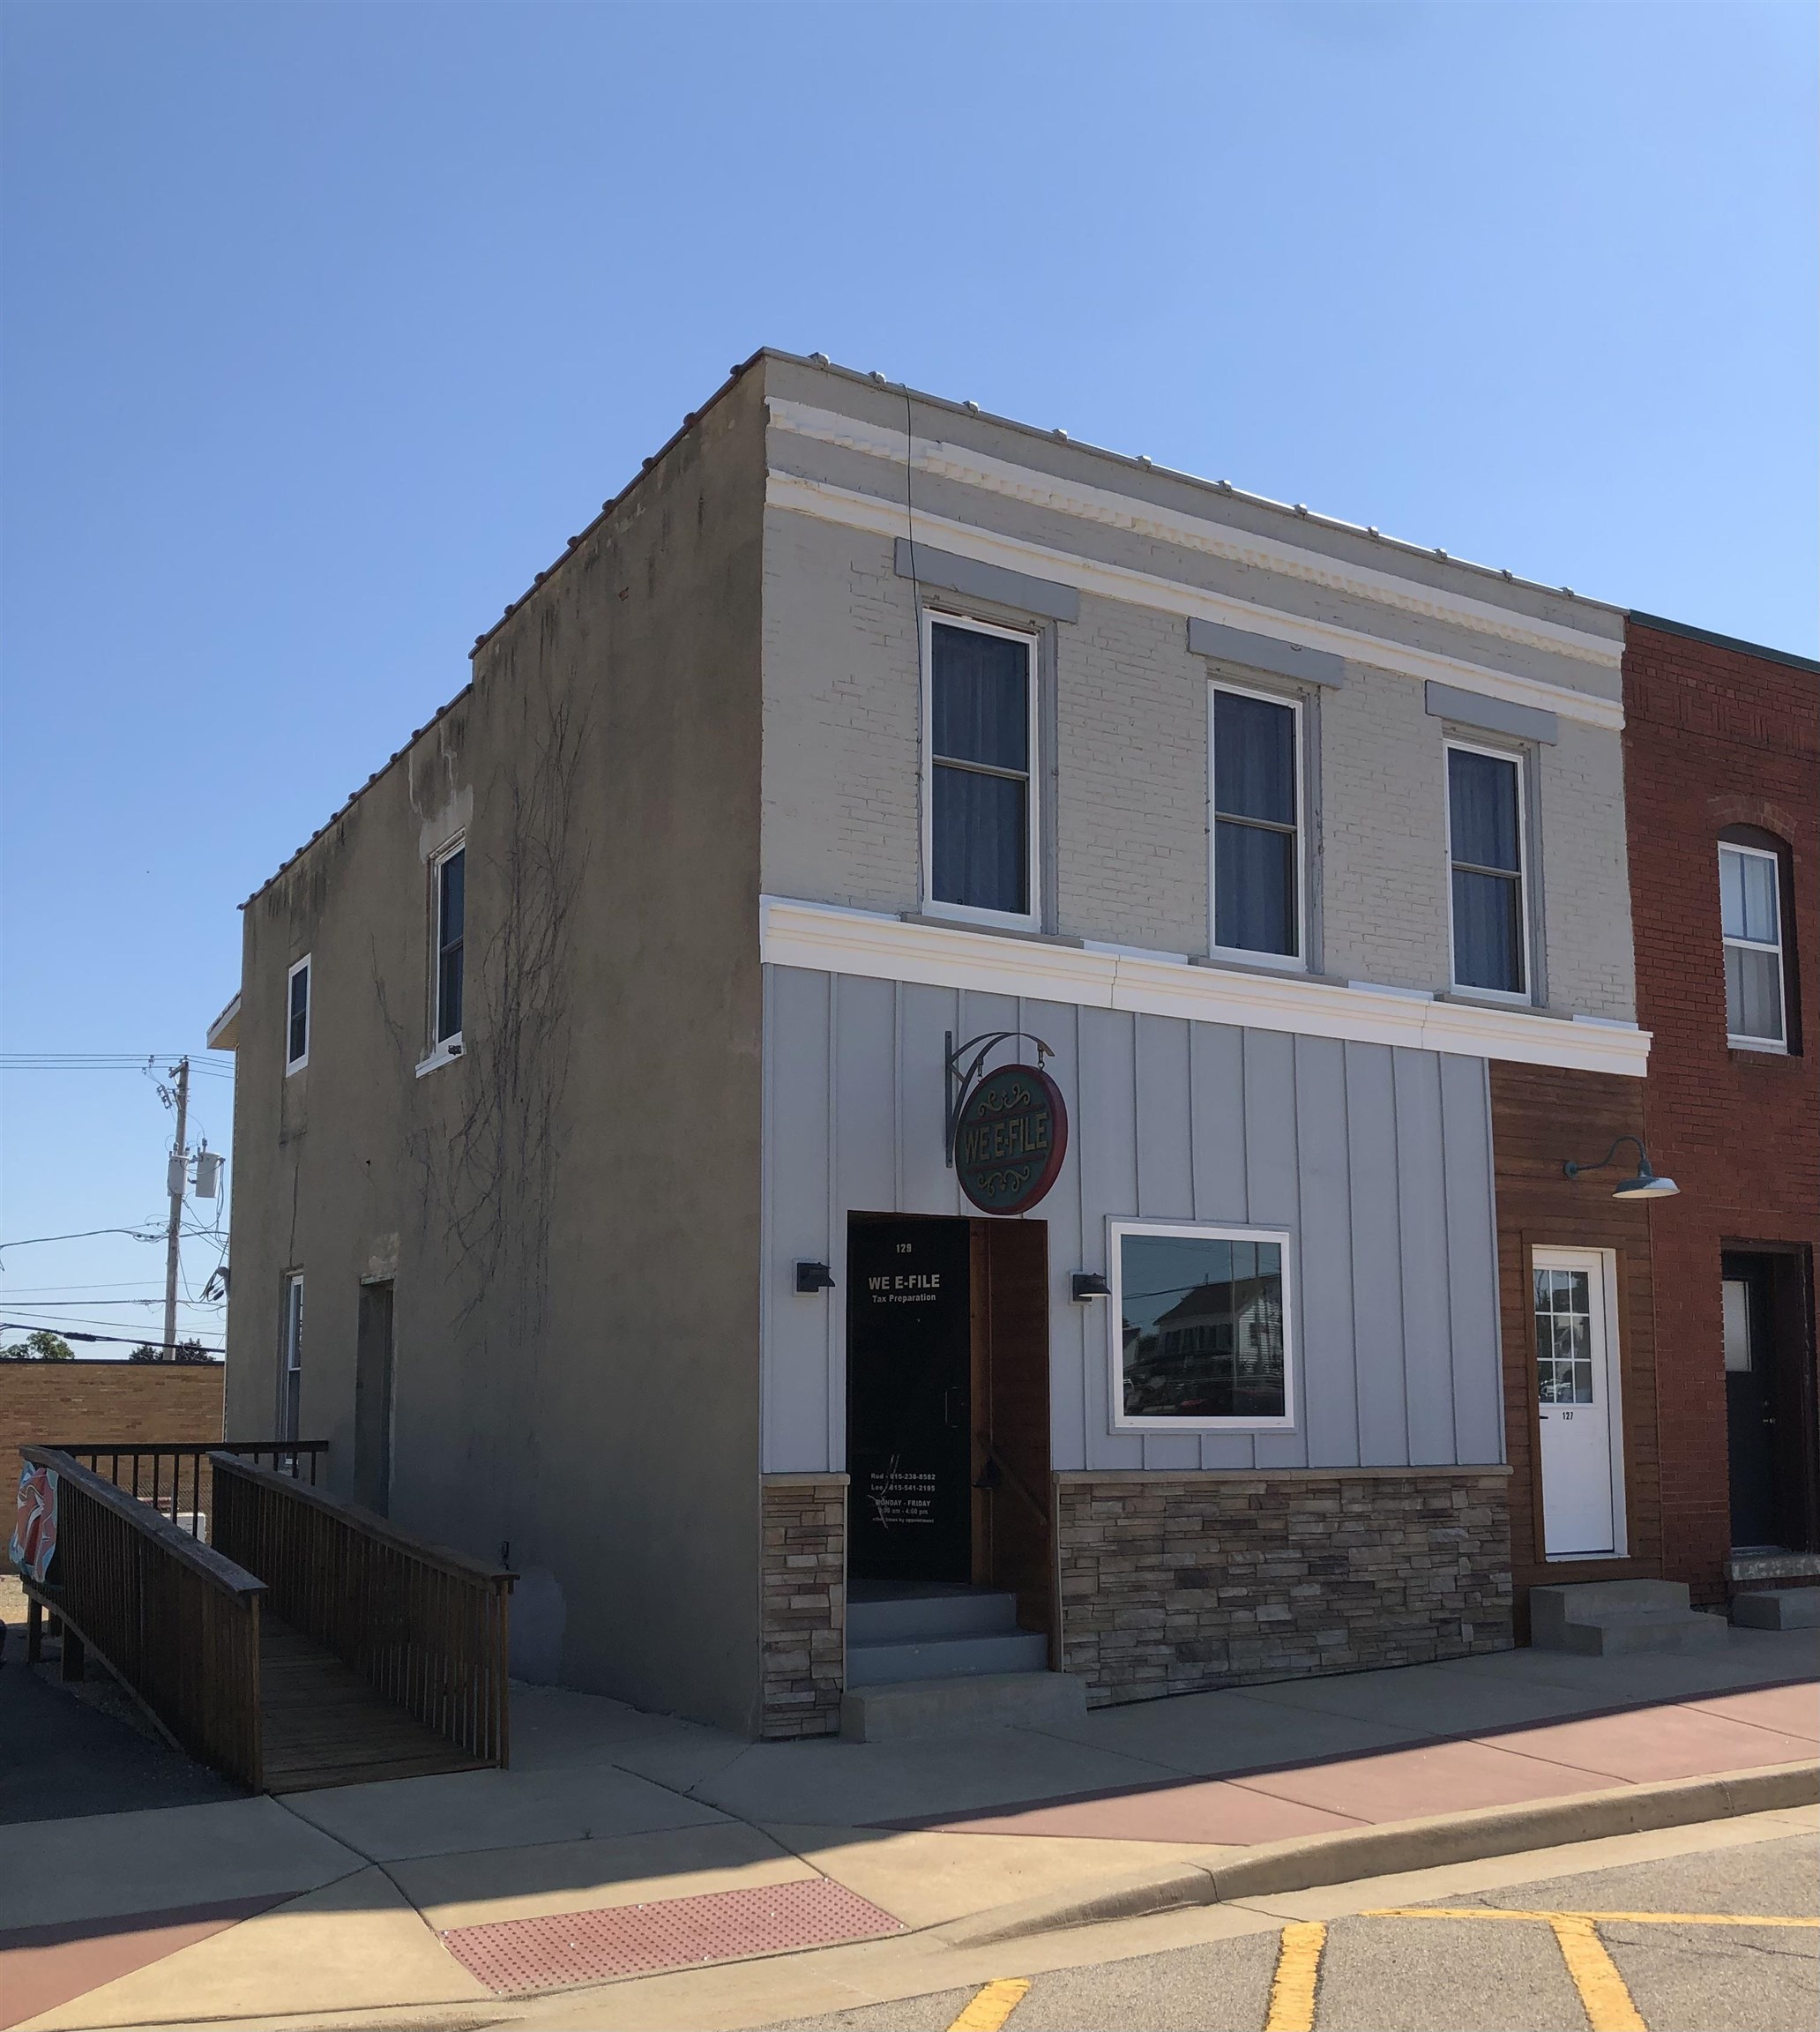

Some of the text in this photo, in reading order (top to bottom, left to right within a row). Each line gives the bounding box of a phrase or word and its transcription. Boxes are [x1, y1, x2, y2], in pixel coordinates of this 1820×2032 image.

[965, 1112, 1048, 1164] WE E-FILE
[869, 1274, 940, 1290] WE E-FILE
[889, 1293, 936, 1304] Preparation
[1562, 1411, 1574, 1420] 127
